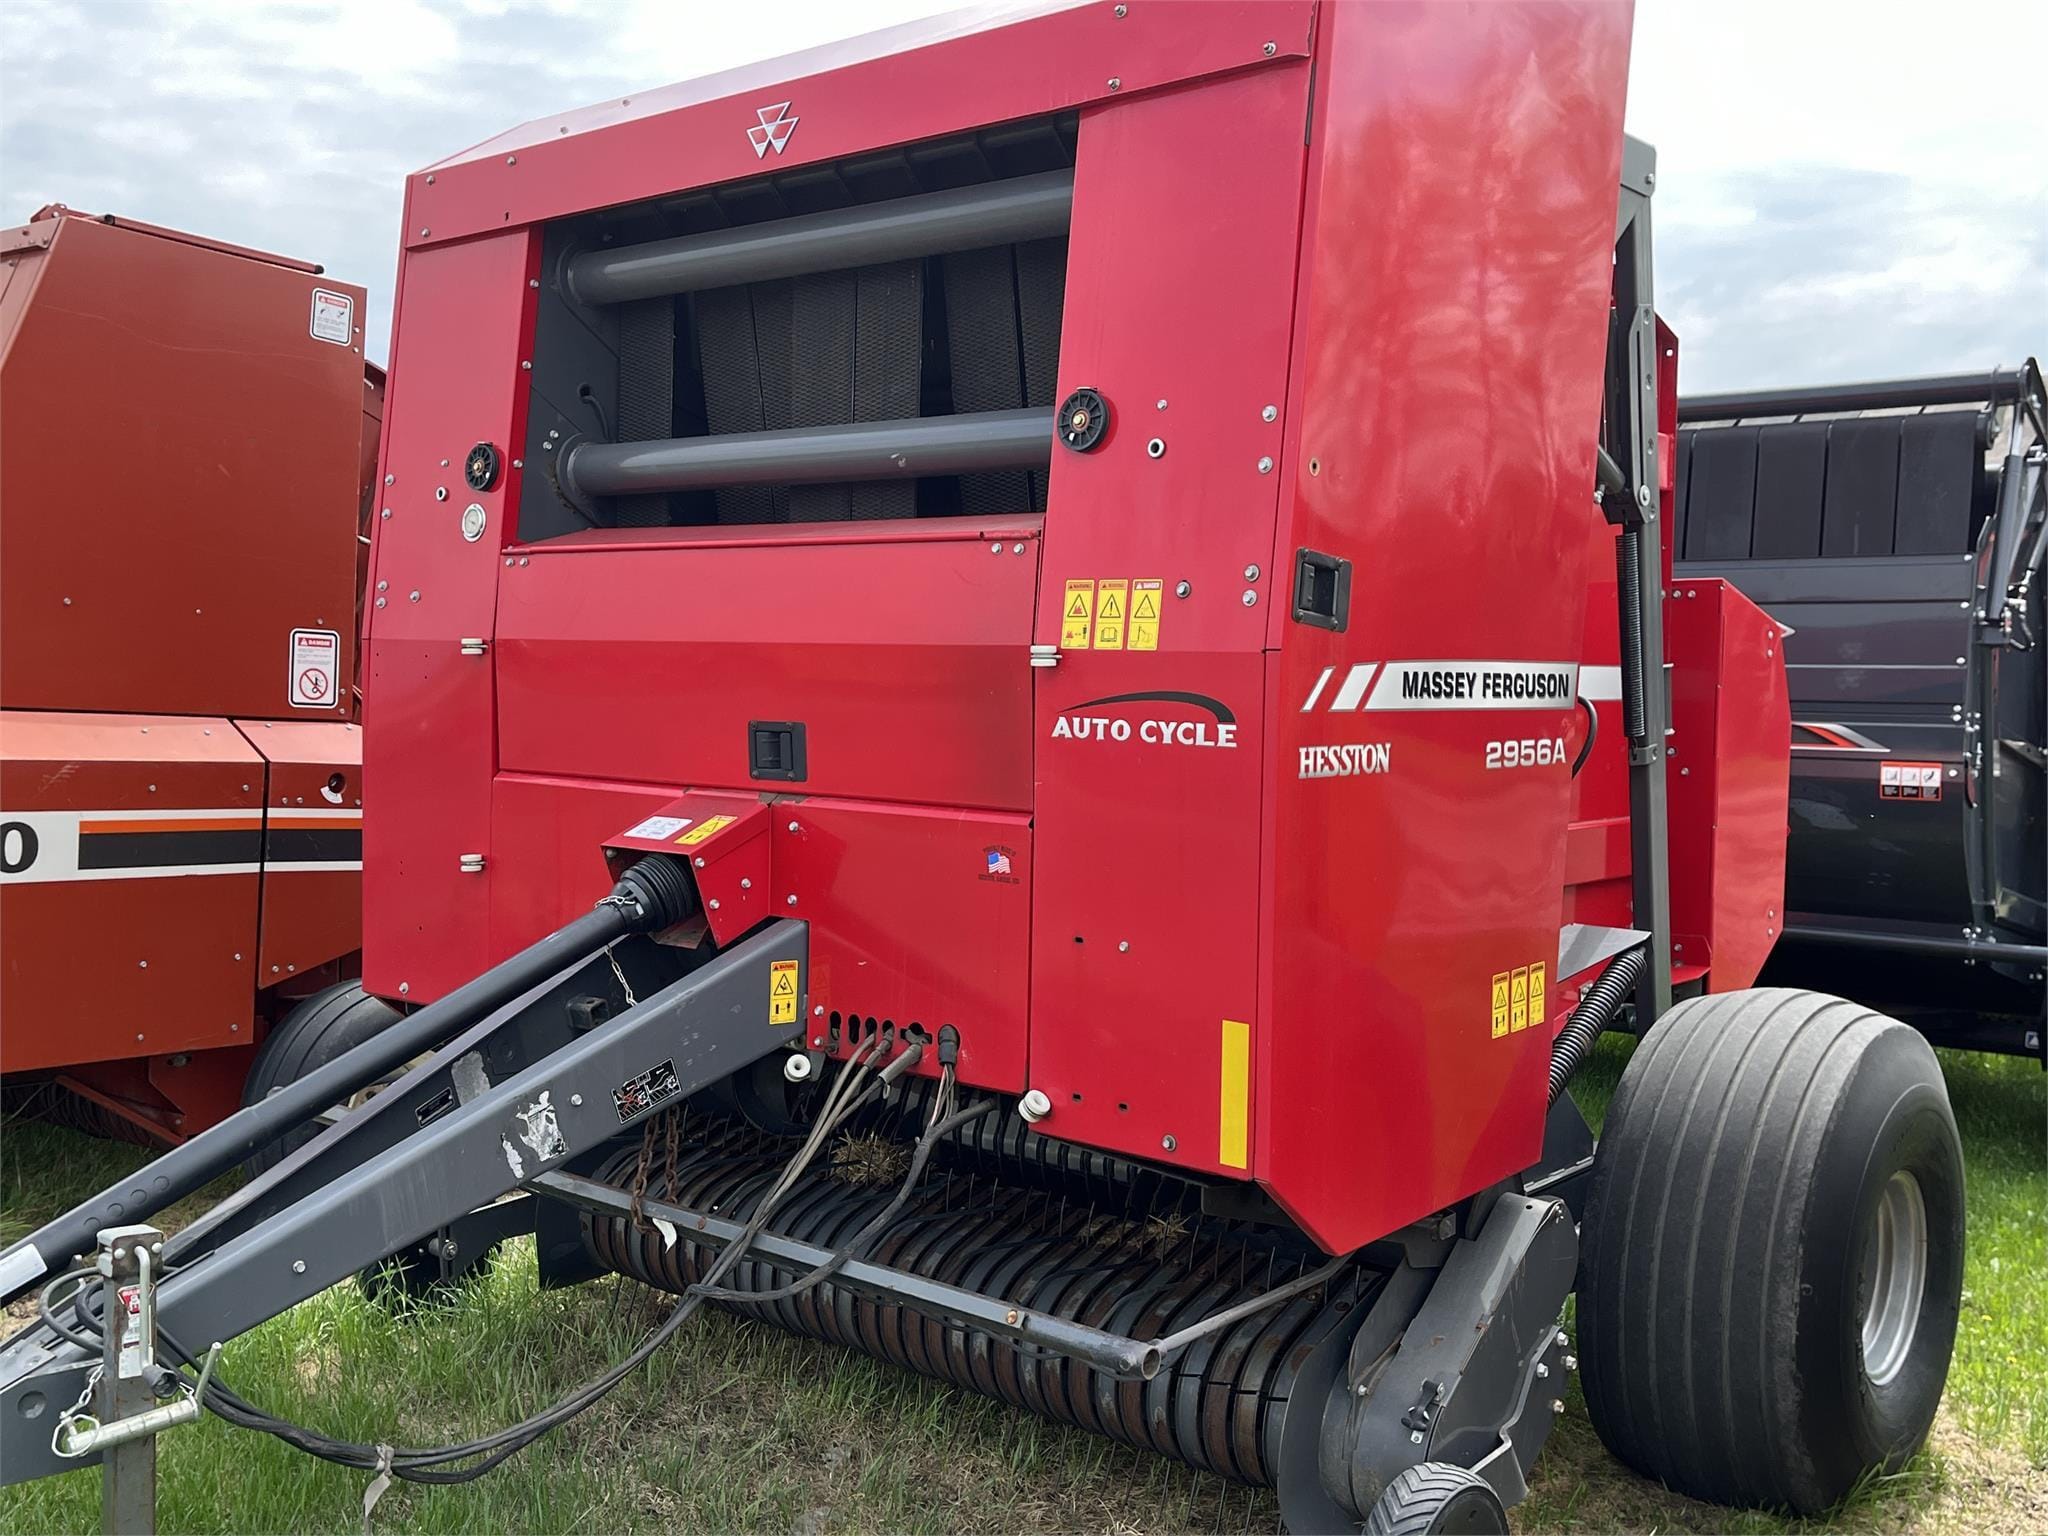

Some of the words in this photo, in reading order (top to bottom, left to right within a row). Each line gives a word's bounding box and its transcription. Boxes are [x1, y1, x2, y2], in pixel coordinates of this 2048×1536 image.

[1402, 671, 1477, 699] MASSEY
[1482, 672, 1569, 699] FERGUSON
[1051, 716, 1131, 741] AUTO
[1139, 720, 1237, 748] CYCLE
[1298, 742, 1392, 779] HESSTON
[1485, 738, 1567, 769] 2956A
